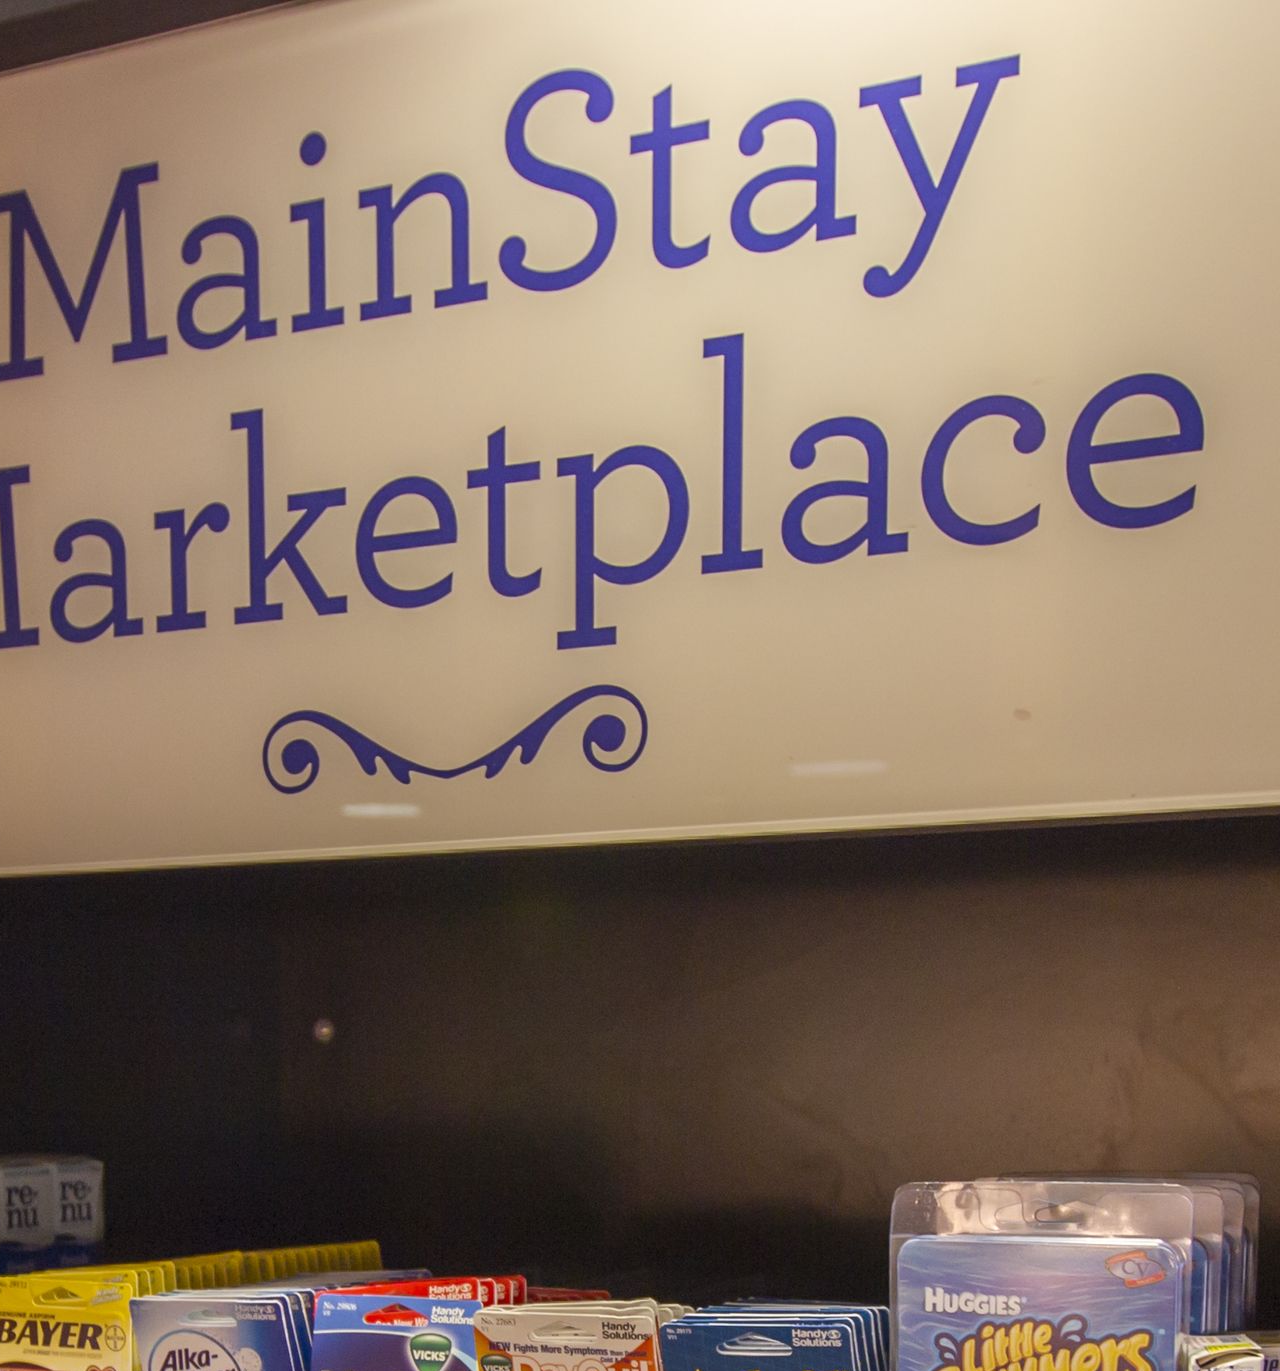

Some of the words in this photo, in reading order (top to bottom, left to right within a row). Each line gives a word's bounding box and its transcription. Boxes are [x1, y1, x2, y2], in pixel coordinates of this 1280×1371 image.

[429, 1283, 460, 1294] Handy
[924, 1286, 1022, 1316] HUGGIES
[235, 1311, 277, 1322] Solutions
[431, 1305, 465, 1318] Handy
[601, 1321, 637, 1333] Handy
[601, 1330, 649, 1341] Solutions
[791, 1328, 829, 1341] Handy
[489, 1341, 511, 1352] NEW
[513, 1343, 539, 1355] Fights
[541, 1344, 562, 1354] More
[563, 1345, 609, 1357] Symptoms
[791, 1338, 842, 1348] Solutions
[413, 1350, 447, 1362] VICKS
